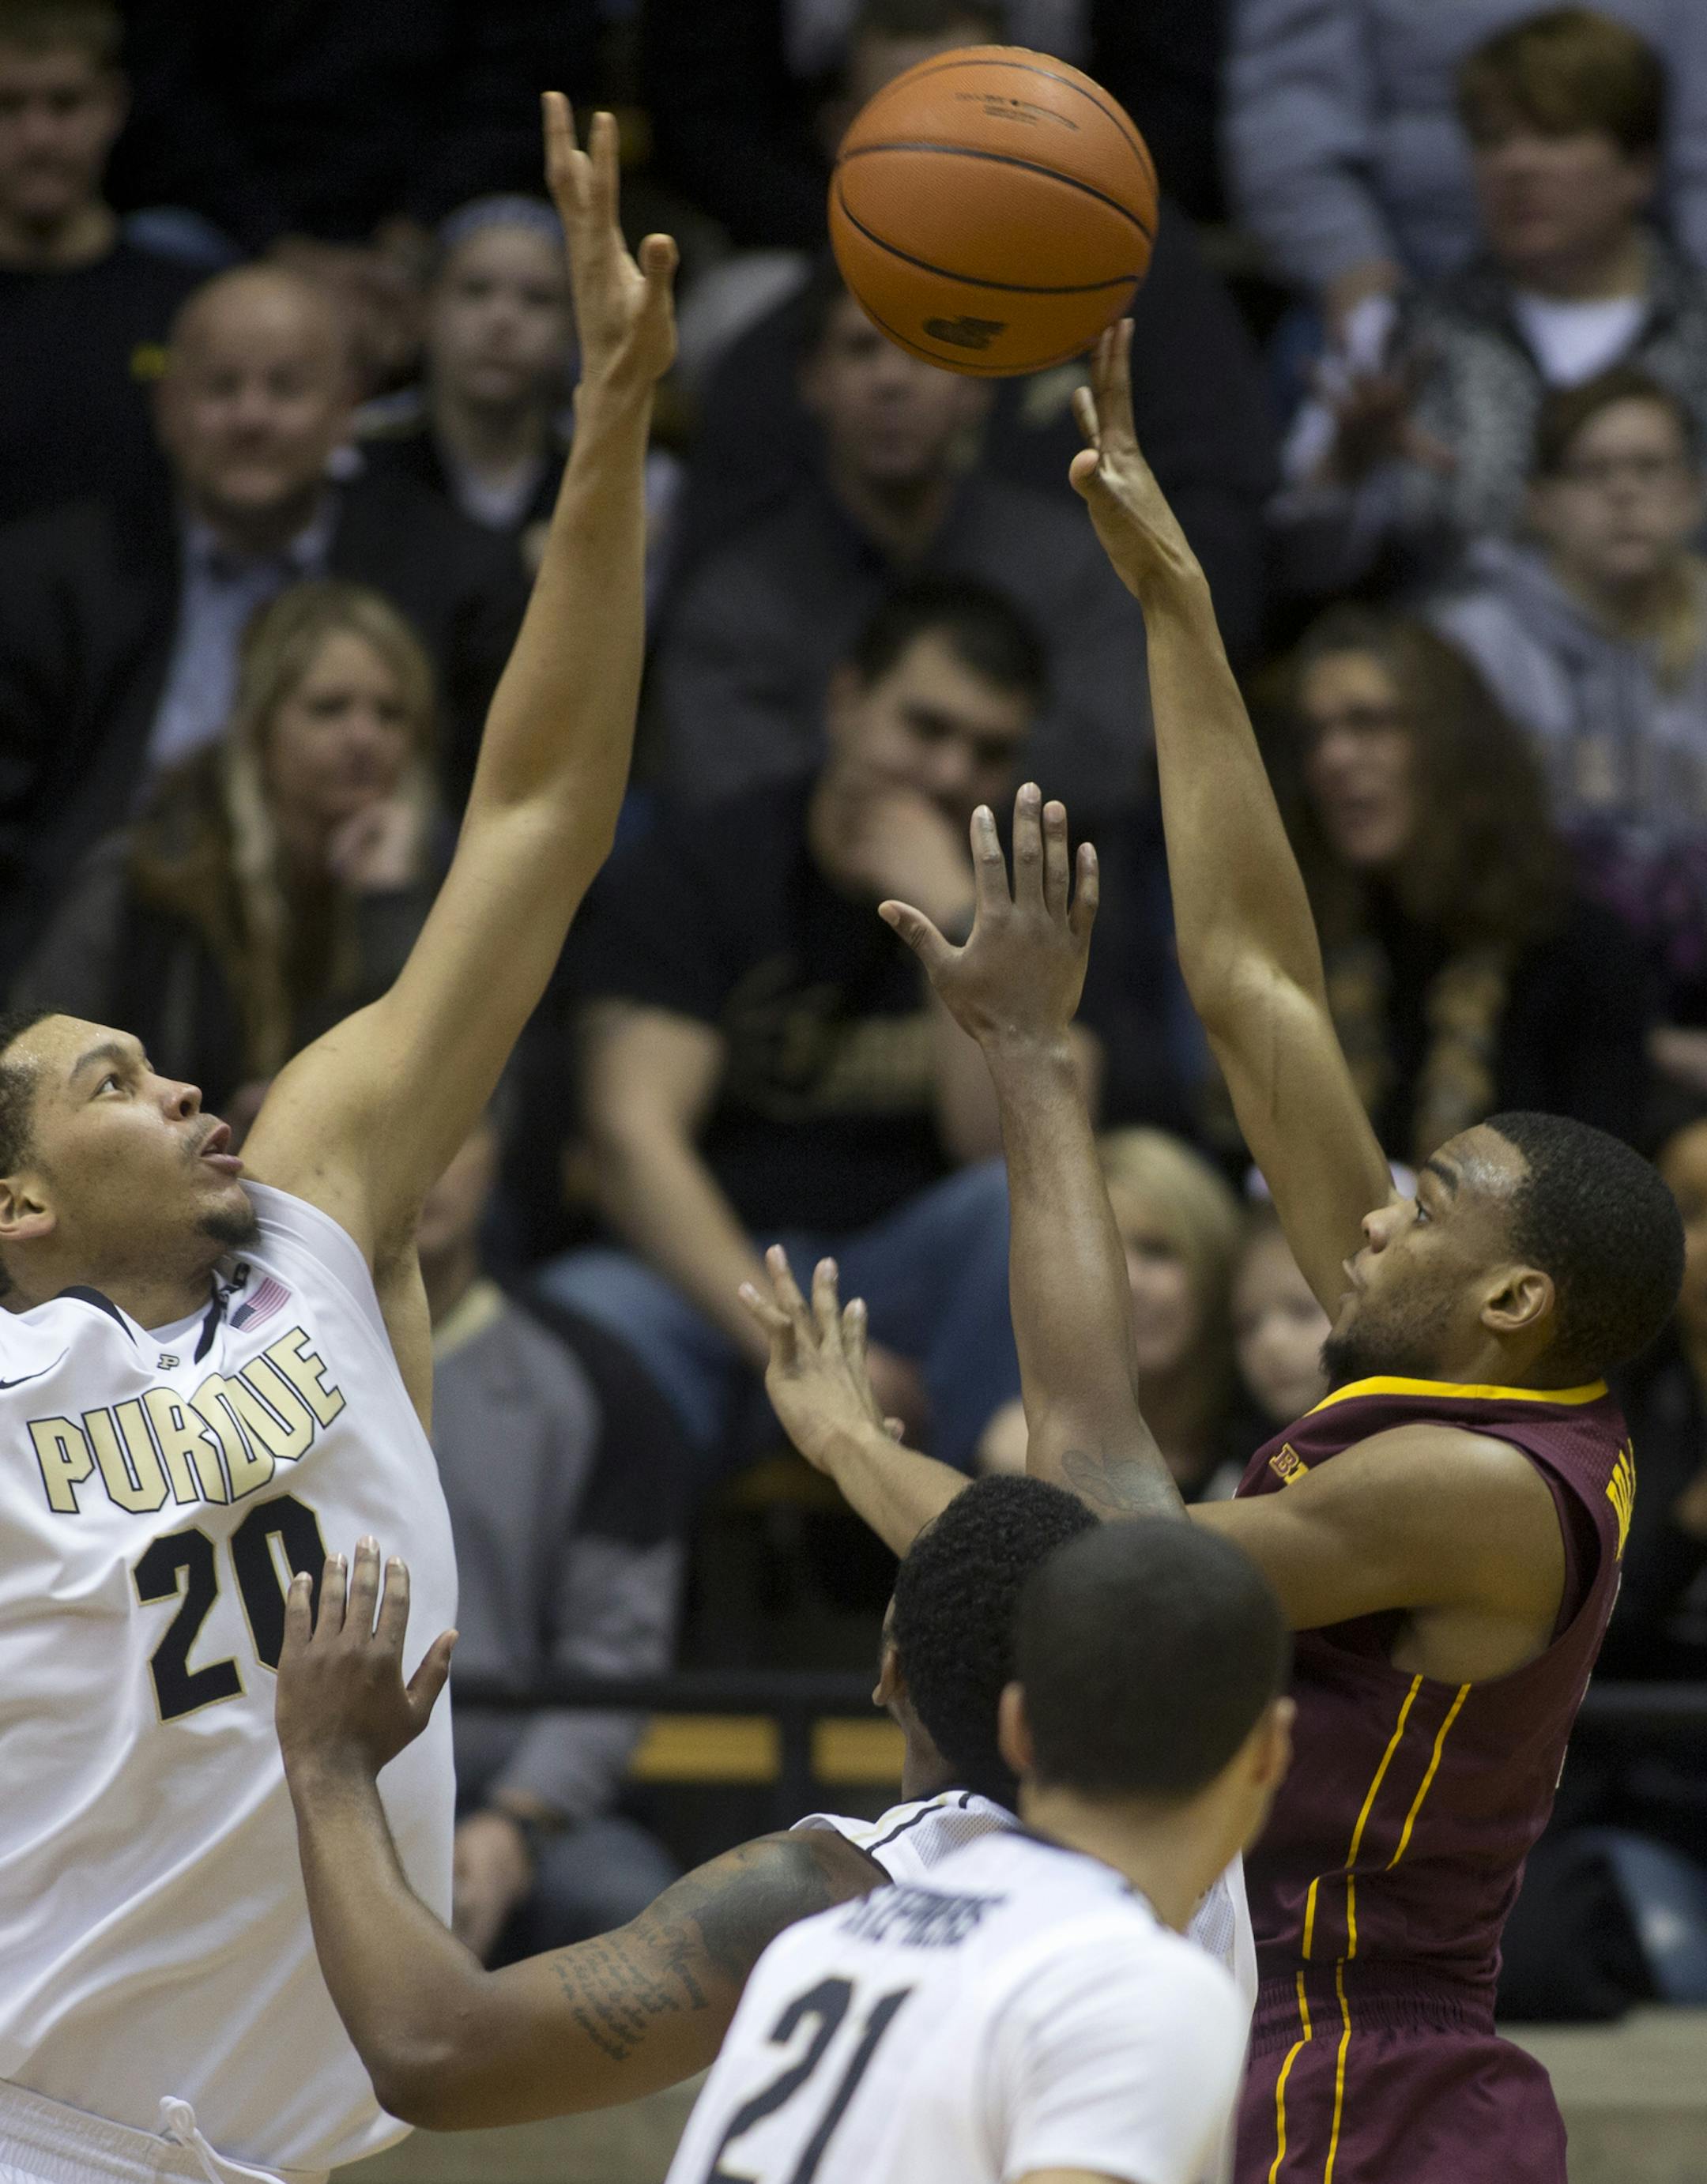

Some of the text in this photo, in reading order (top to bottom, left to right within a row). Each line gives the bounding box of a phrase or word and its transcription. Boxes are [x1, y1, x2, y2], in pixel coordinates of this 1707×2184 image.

[27, 1326, 346, 1514] PURDUE
[156, 1354, 180, 1370] P
[131, 1491, 330, 1724] 20
[703, 1975, 915, 2184] 21
